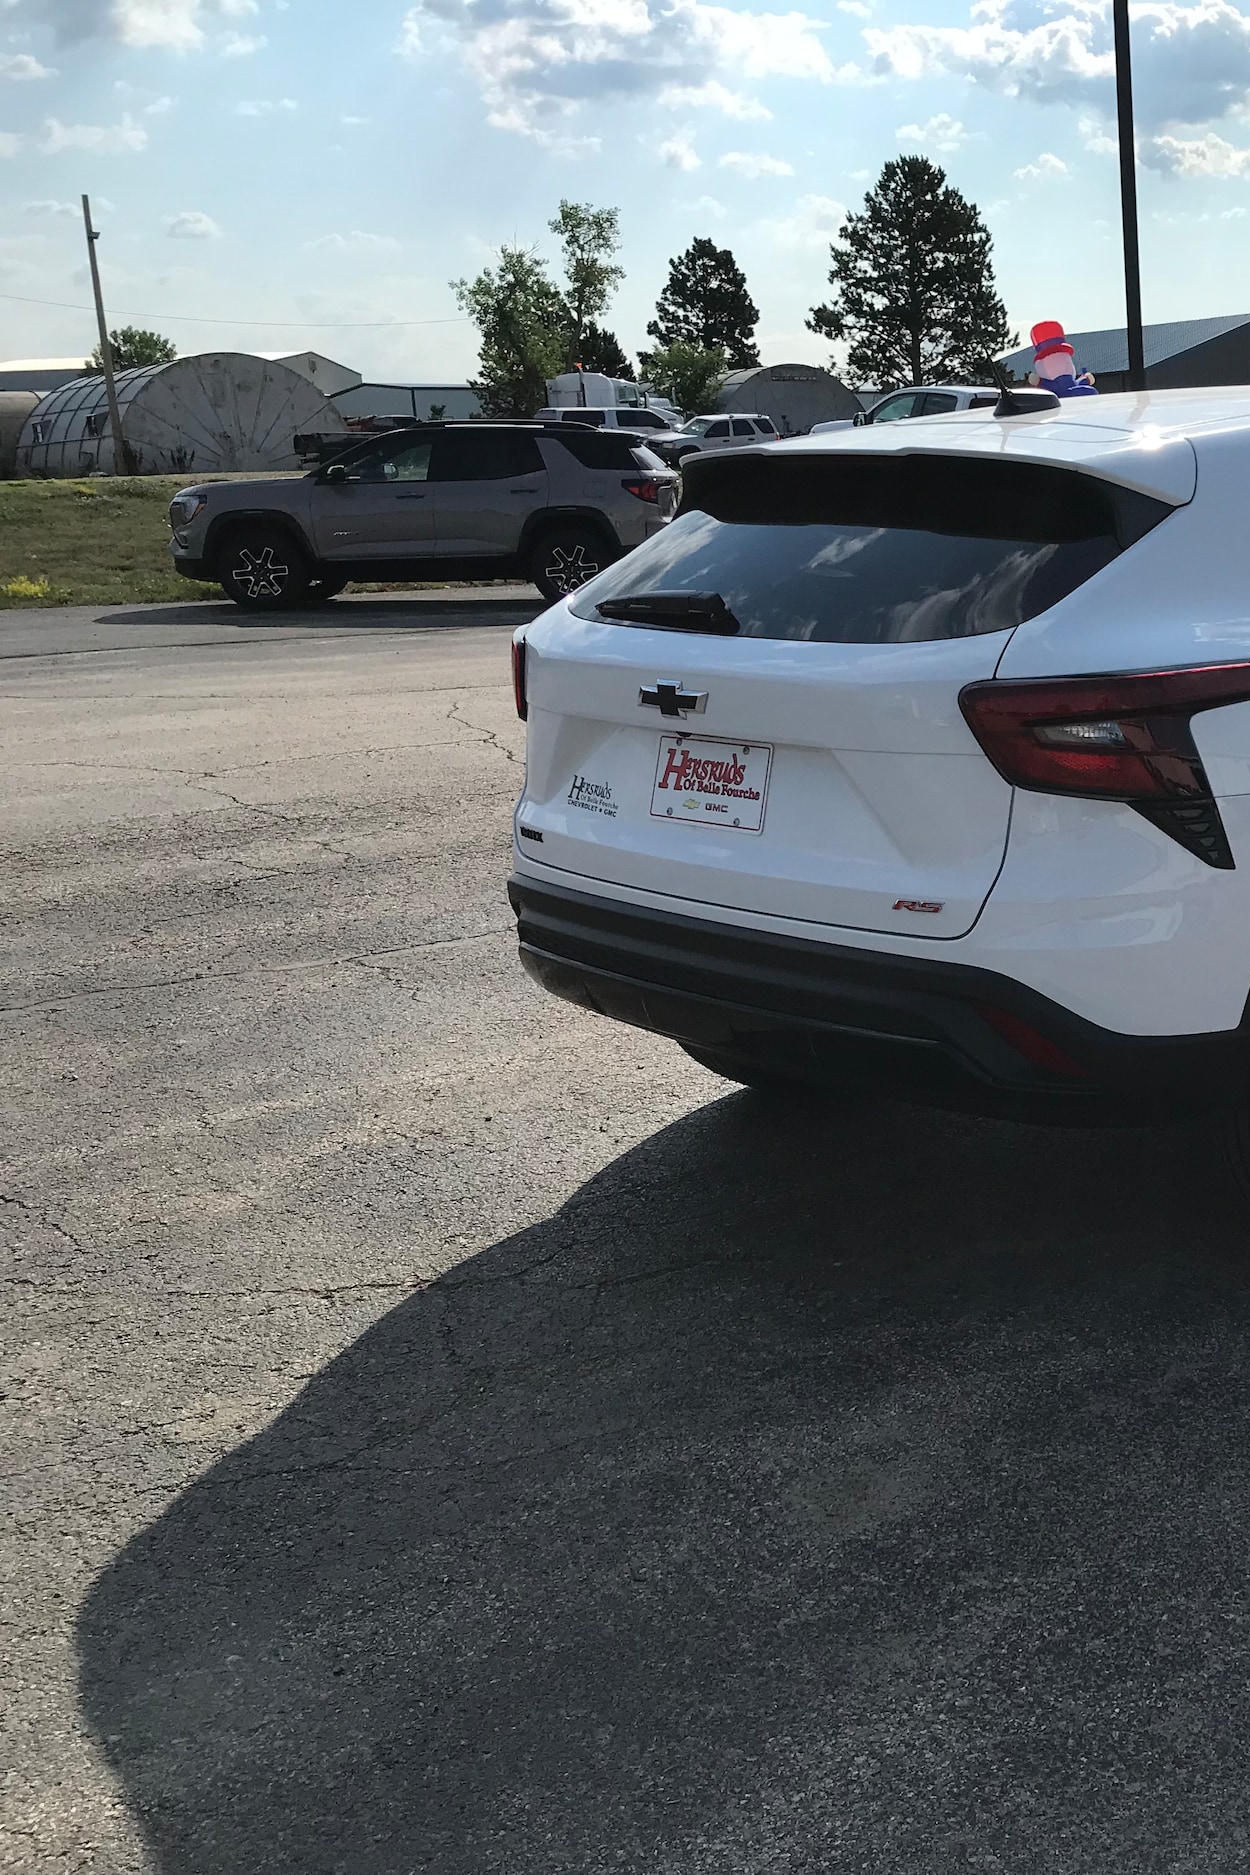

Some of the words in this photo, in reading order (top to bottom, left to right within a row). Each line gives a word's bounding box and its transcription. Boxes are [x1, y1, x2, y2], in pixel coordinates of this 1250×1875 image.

[683, 779, 696, 791] Of
[697, 781, 720, 795] Belle
[721, 784, 760, 800] Fourche
[567, 799, 598, 812] CHEVROLET
[603, 808, 617, 818] GMC
[705, 803, 729, 813] GMC
[892, 898, 945, 913] RS
